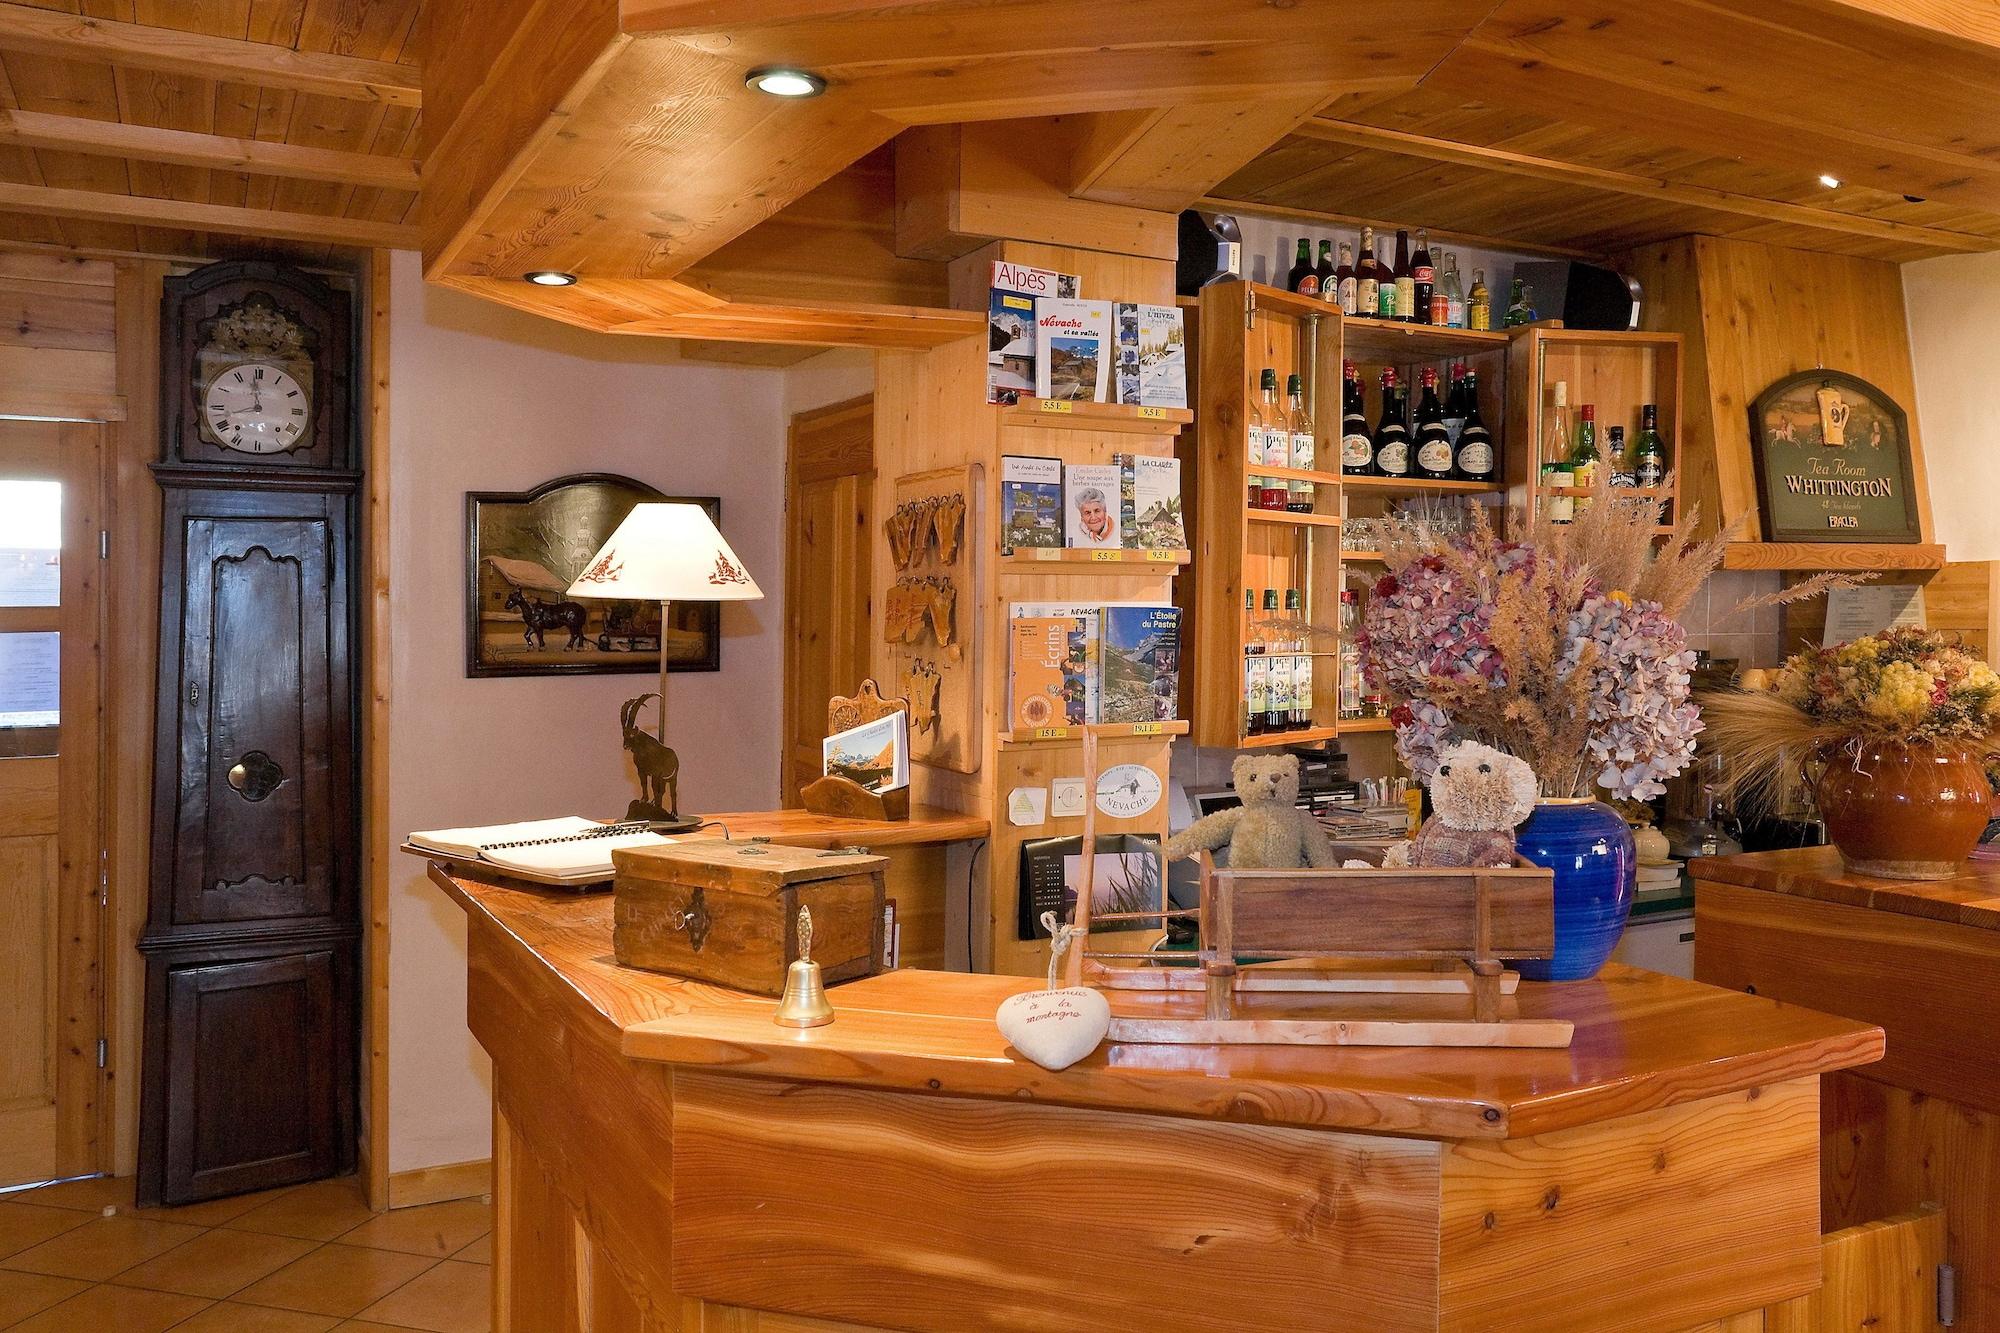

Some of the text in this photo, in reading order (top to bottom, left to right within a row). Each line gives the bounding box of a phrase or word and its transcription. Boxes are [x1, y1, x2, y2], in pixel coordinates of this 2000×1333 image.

[997, 263, 1046, 291] Alpes
[1147, 311, 1175, 320] L'HIVER
[1142, 459, 1150, 467] LA
[1807, 457, 1866, 477] Tea Room
[1073, 472, 1085, 480] Une
[1072, 479, 1090, 487] herbes
[1785, 475, 1892, 498] WHITTINGTON
[1828, 515, 1859, 528] ERACLEA
[1150, 610, 1177, 620] L'Étoile
[1142, 620, 1177, 629] du Pastre
[1040, 624, 1060, 668] Écrins
[1041, 729, 1050, 737] 15
[1106, 795, 1149, 811] NEVACHE
[1013, 990, 1088, 1006] Bienvenue
[1029, 998, 1073, 1010] à la
[1025, 1010, 1082, 1024] montagne
